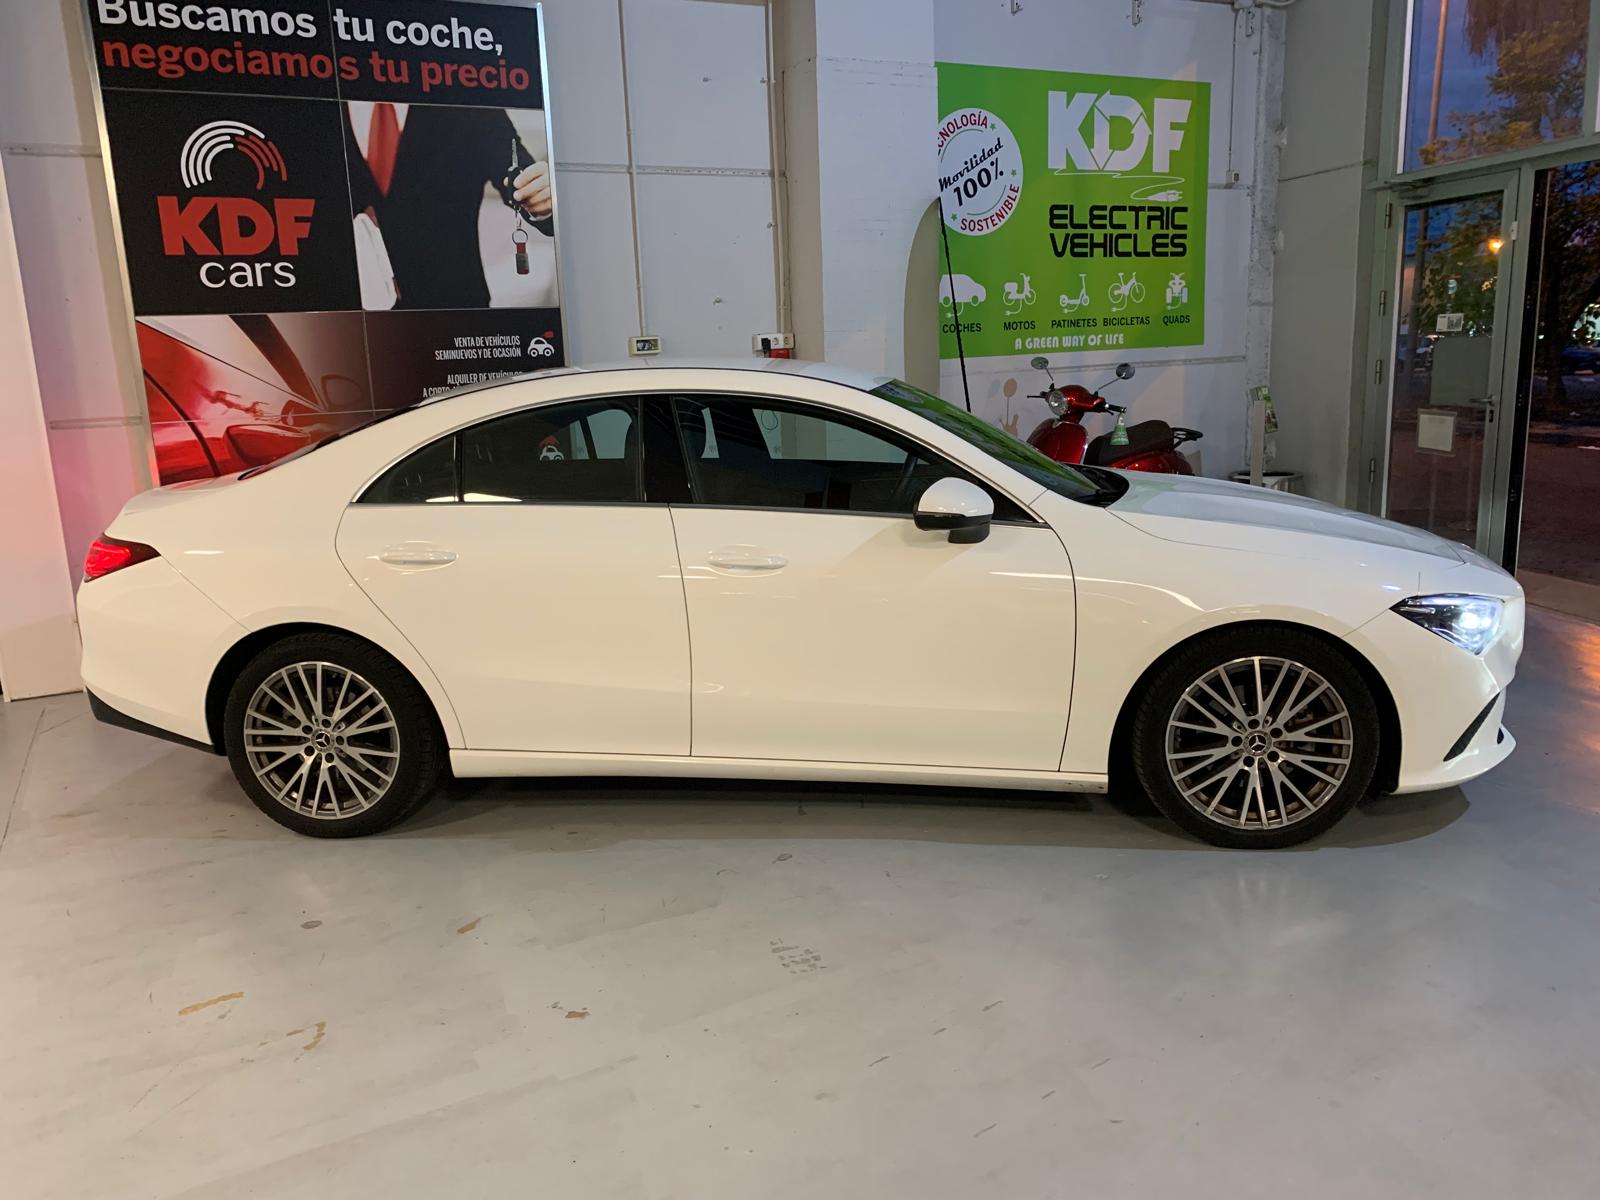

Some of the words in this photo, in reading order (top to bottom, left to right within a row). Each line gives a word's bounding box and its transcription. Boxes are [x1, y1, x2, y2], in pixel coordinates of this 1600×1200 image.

[97, 0, 317, 38] Buscamos
[333, 8, 374, 42] tu
[386, 17, 502, 56] coche,
[103, 41, 359, 80] negociamos
[369, 50, 410, 84] tu
[420, 59, 529, 92] precio
[1048, 89, 1192, 173] KDF
[938, 137, 1003, 192] Movilidad
[953, 157, 1004, 206] 100%
[960, 183, 1020, 232] SOSTENIBLE
[1048, 204, 1188, 230] ELECTRIC
[157, 196, 315, 257] KDF
[1049, 233, 1188, 258] VEHICLES
[199, 258, 296, 289] cars
[942, 322, 982, 334] COCHES
[1003, 320, 1036, 331] MOTOS
[1051, 317, 1098, 329] PATINETES
[1103, 316, 1150, 327] BICICLETAS
[1162, 314, 1191, 325] QUADS
[435, 348, 477, 361] SEMINUEVOS
[478, 348, 483, 358] Y
[483, 348, 492, 358] DE
[493, 345, 521, 358] OCASIÓN
[454, 337, 476, 348] VENTA
[476, 336, 484, 347] DE
[485, 333, 520, 347] VEHÍCULOS
[1015, 338, 1022, 350] A
[1026, 337, 1059, 349] GREEN
[1062, 335, 1086, 348] WAY
[1088, 334, 1101, 346] OF
[1105, 333, 1124, 345] LIFE
[447, 373, 478, 386] ALQUILER
